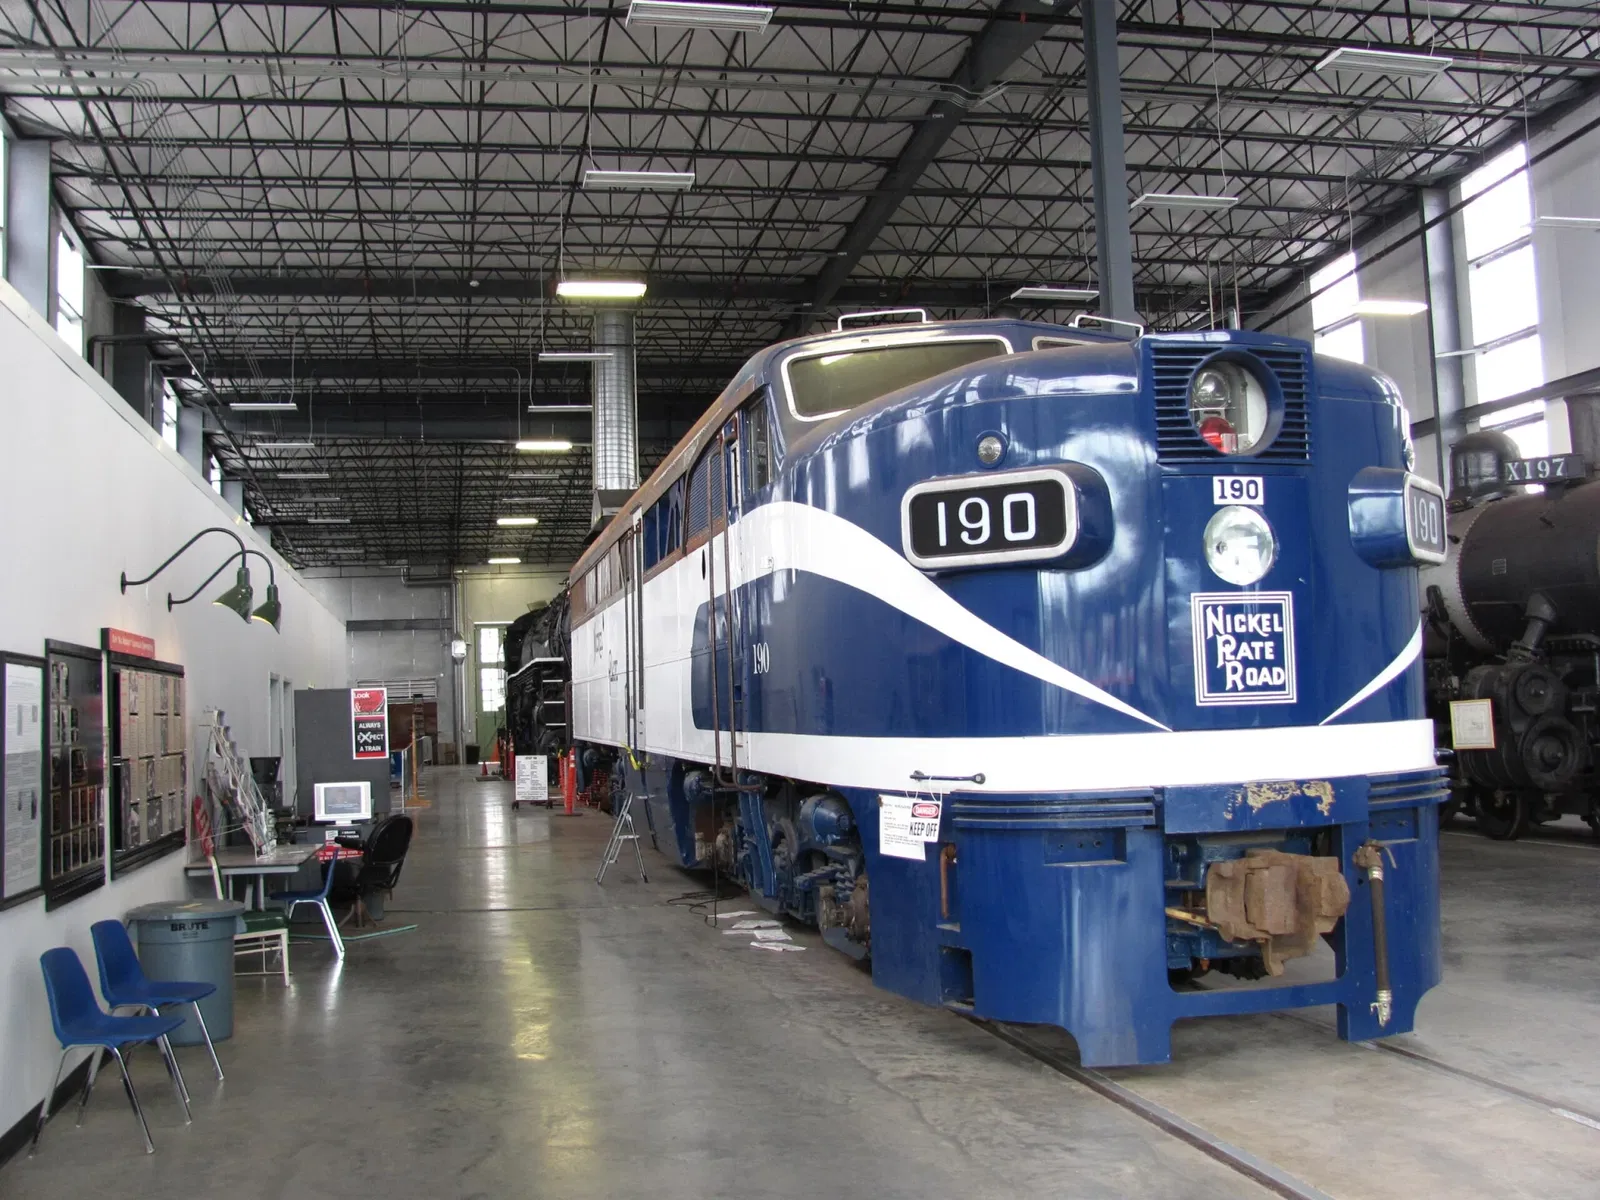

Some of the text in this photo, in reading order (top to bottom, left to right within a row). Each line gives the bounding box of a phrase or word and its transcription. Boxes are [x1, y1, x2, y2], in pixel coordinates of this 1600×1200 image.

[1506, 457, 1565, 481] X197
[1217, 479, 1259, 500] 190
[937, 492, 1036, 547] 190
[1413, 495, 1439, 545] 190
[1205, 605, 1283, 640] NICKEL
[752, 642, 770, 674] 190
[1225, 660, 1285, 691] ROAD
[357, 731, 384, 744] EXPECT
[909, 822, 925, 836] KEEP
[926, 822, 938, 837] OFF
